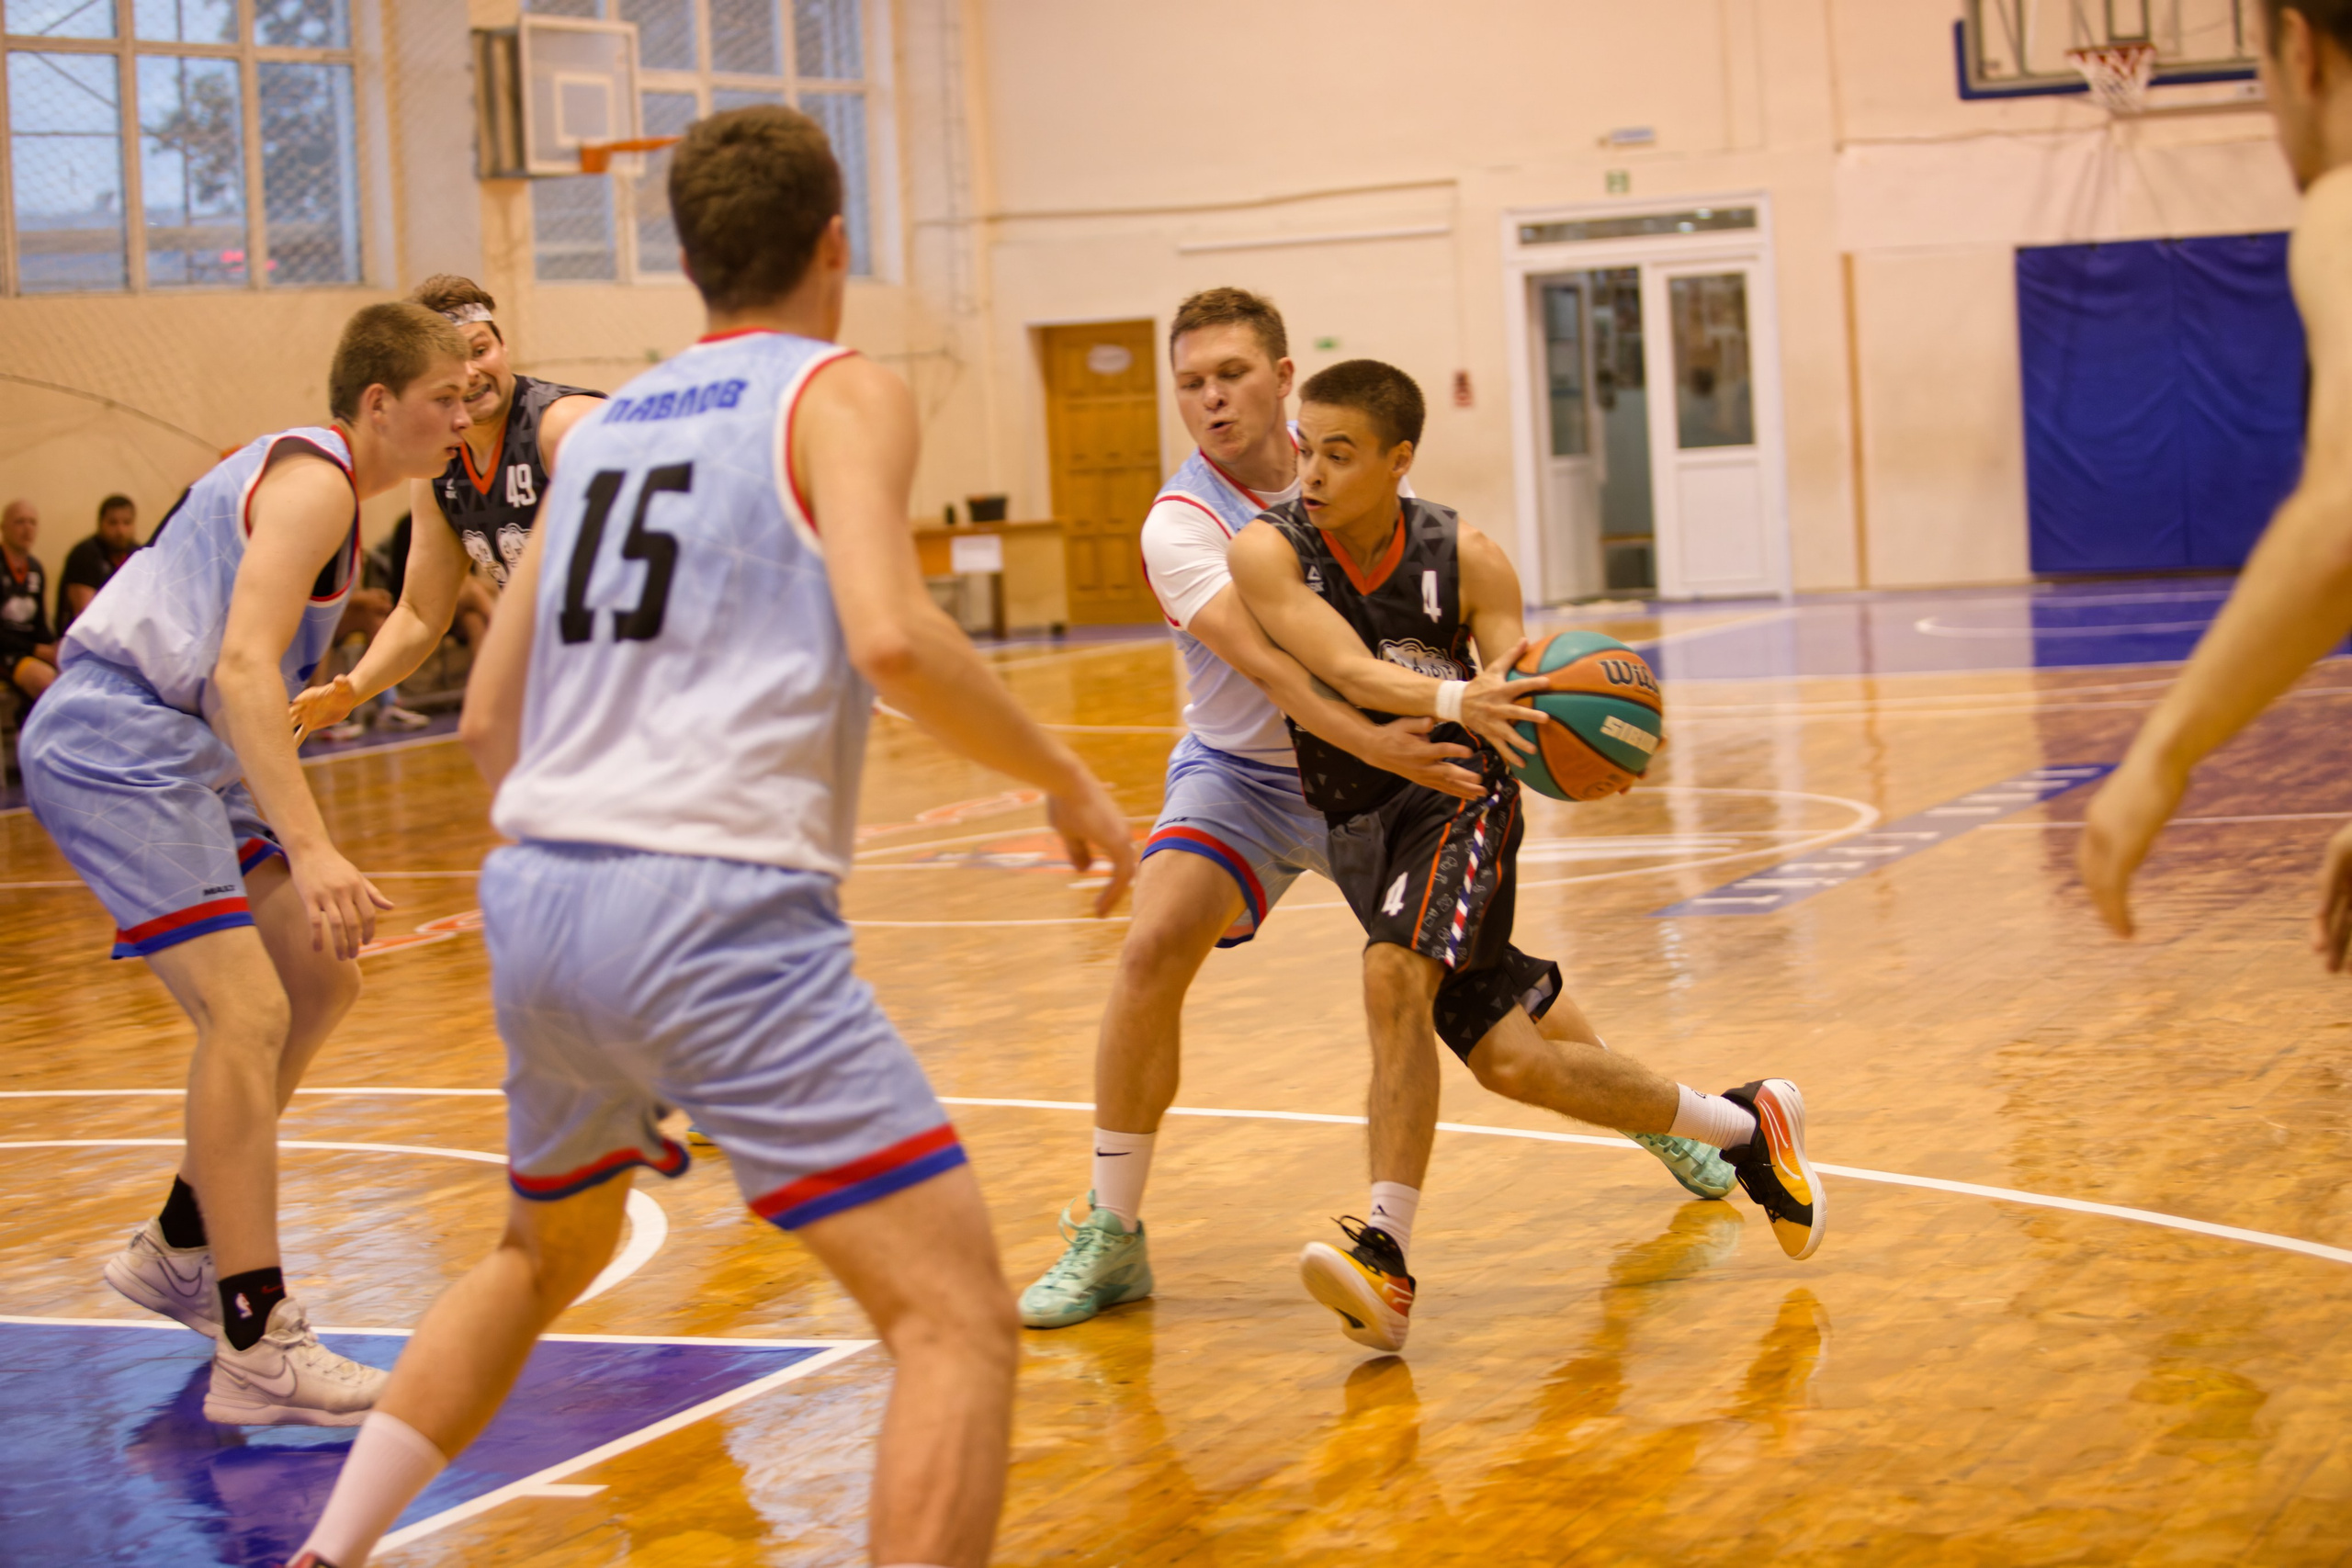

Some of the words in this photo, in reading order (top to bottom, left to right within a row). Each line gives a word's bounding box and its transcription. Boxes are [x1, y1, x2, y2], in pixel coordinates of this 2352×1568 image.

[602, 378, 749, 424] ПАВЛОВ
[506, 463, 537, 508] 49
[559, 460, 694, 646] 15
[1421, 570, 1442, 624] 4
[1599, 660, 1660, 695] Wil
[1600, 715, 1659, 755] SIBU
[1381, 871, 1409, 917] 4
